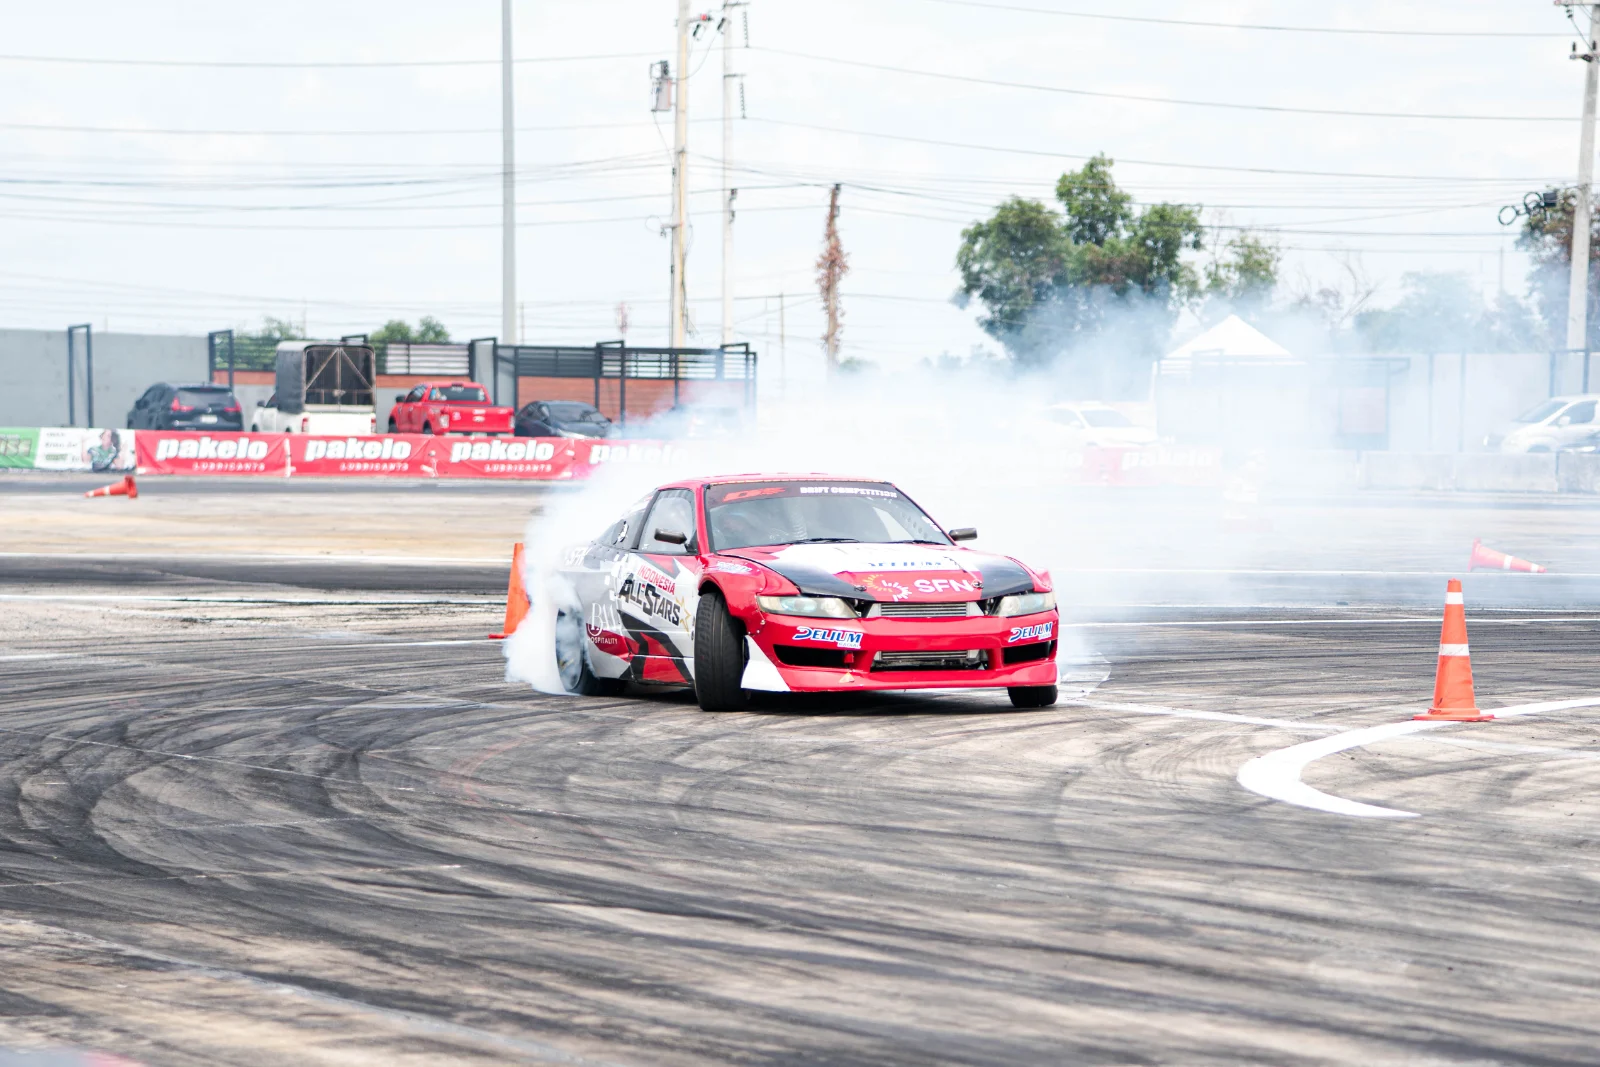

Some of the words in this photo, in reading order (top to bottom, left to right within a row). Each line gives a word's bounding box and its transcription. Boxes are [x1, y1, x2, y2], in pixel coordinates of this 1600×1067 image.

[156, 436, 268, 461] pakelo
[304, 437, 412, 462] pakelo
[450, 439, 555, 463] pakelo
[192, 462, 266, 471] LUBRICANTS
[340, 462, 409, 471] LUBRICANTS
[484, 463, 552, 473] LUBRICANTS
[637, 564, 676, 596] INDONESIA
[913, 579, 974, 593] SFN
[588, 636, 618, 645] HOSPITALITY
[792, 626, 863, 643] DELIUM
[1008, 622, 1053, 642] DELIUM
